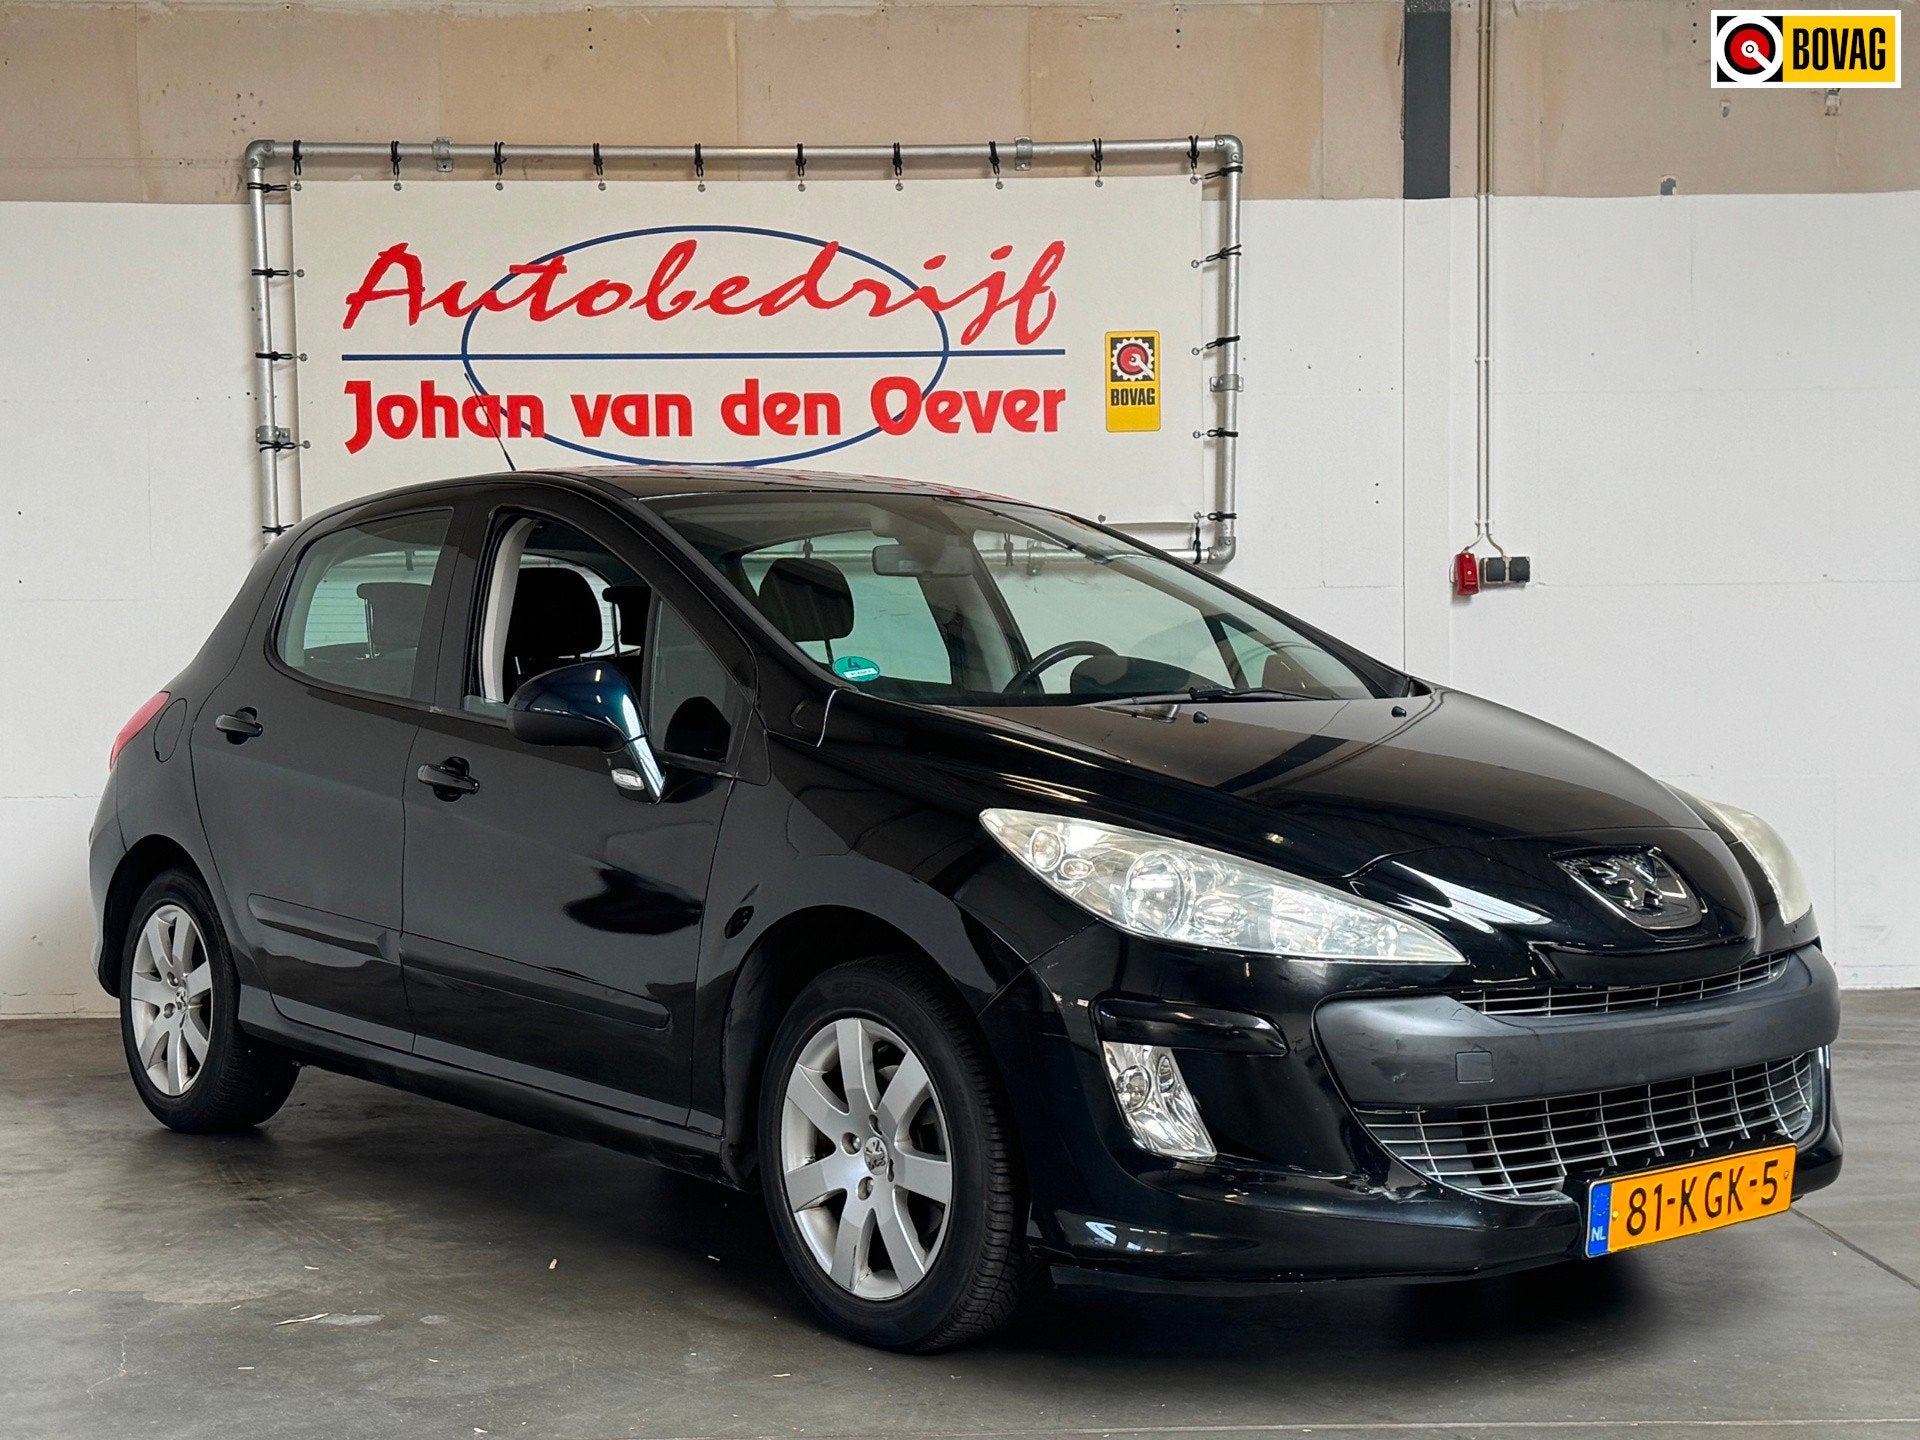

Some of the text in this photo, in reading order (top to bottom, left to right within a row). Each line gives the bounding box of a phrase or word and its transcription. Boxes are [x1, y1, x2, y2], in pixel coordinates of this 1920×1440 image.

[343, 240, 1066, 346] Autobedrijf
[344, 375, 1067, 454] Johan van den Oever
[1110, 387, 1156, 406] BOVAG
[1590, 1225, 1606, 1242] NL
[1626, 1159, 1778, 1237] 81-KGK-5
